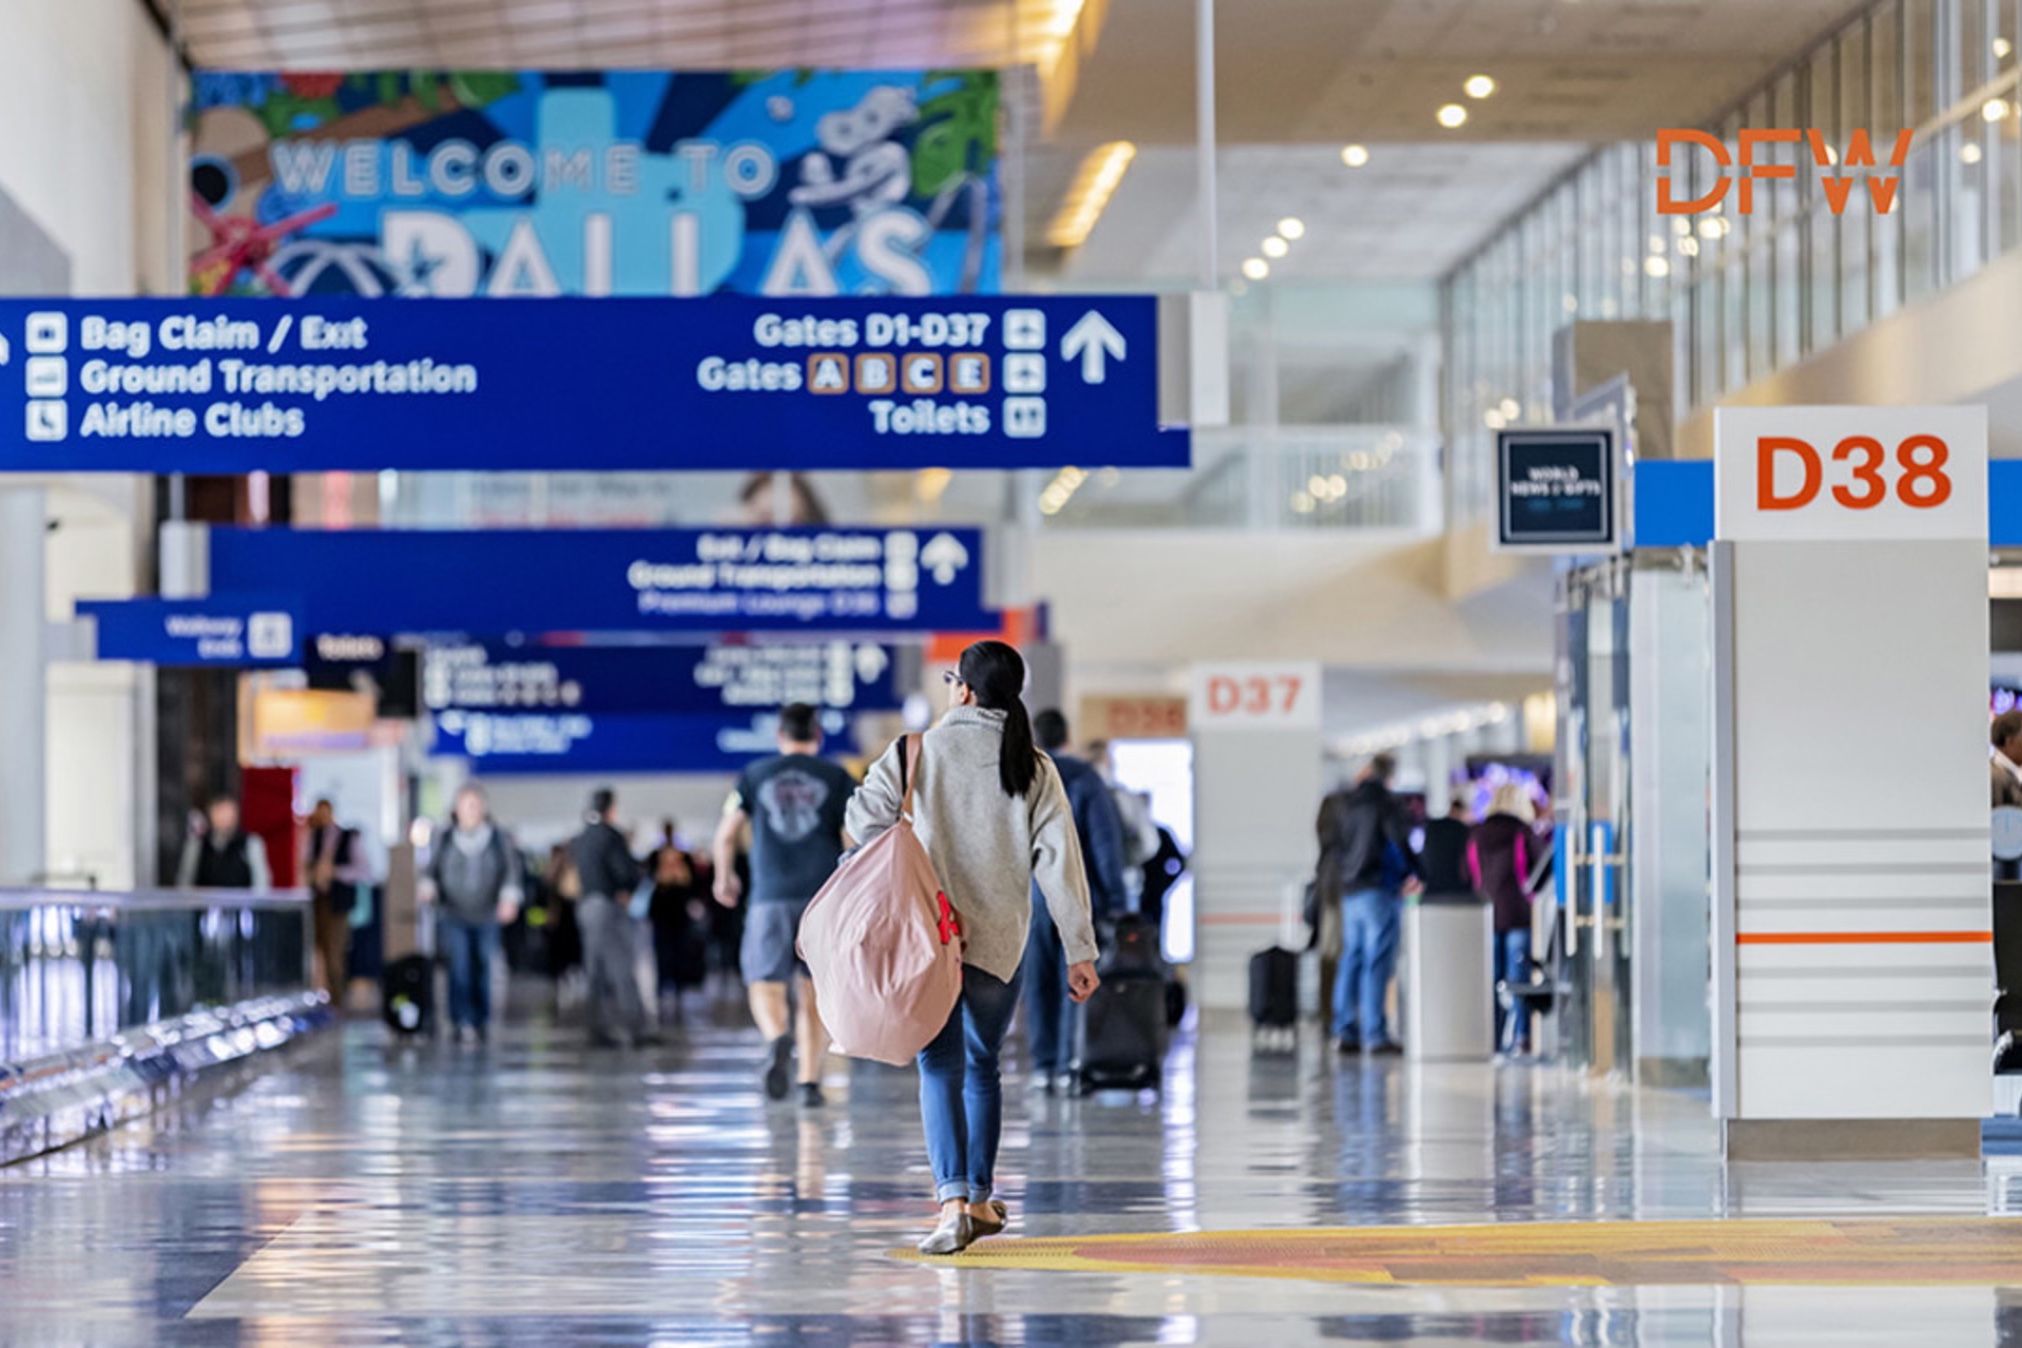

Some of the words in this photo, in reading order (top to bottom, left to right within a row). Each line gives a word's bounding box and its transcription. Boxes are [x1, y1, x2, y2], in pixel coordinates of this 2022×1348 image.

[269, 143, 642, 196] WELCOME
[677, 143, 776, 198] TO
[382, 208, 932, 297] DALLAS
[81, 315, 150, 358] Bag
[159, 314, 260, 350] Claim
[300, 315, 368, 350] Exit
[753, 313, 858, 347] Gates
[866, 313, 991, 347] D1-D37
[81, 358, 211, 393] Ground
[218, 358, 478, 401] Transportation
[697, 356, 802, 391] Gates
[812, 357, 845, 390] A
[861, 357, 889, 390] B
[908, 357, 936, 390] C
[956, 357, 983, 390] E
[80, 402, 197, 437] Airline
[204, 402, 305, 437] Clubs
[868, 399, 990, 434] Toilets
[1757, 434, 1952, 511] D38
[1206, 673, 1304, 715] D37
